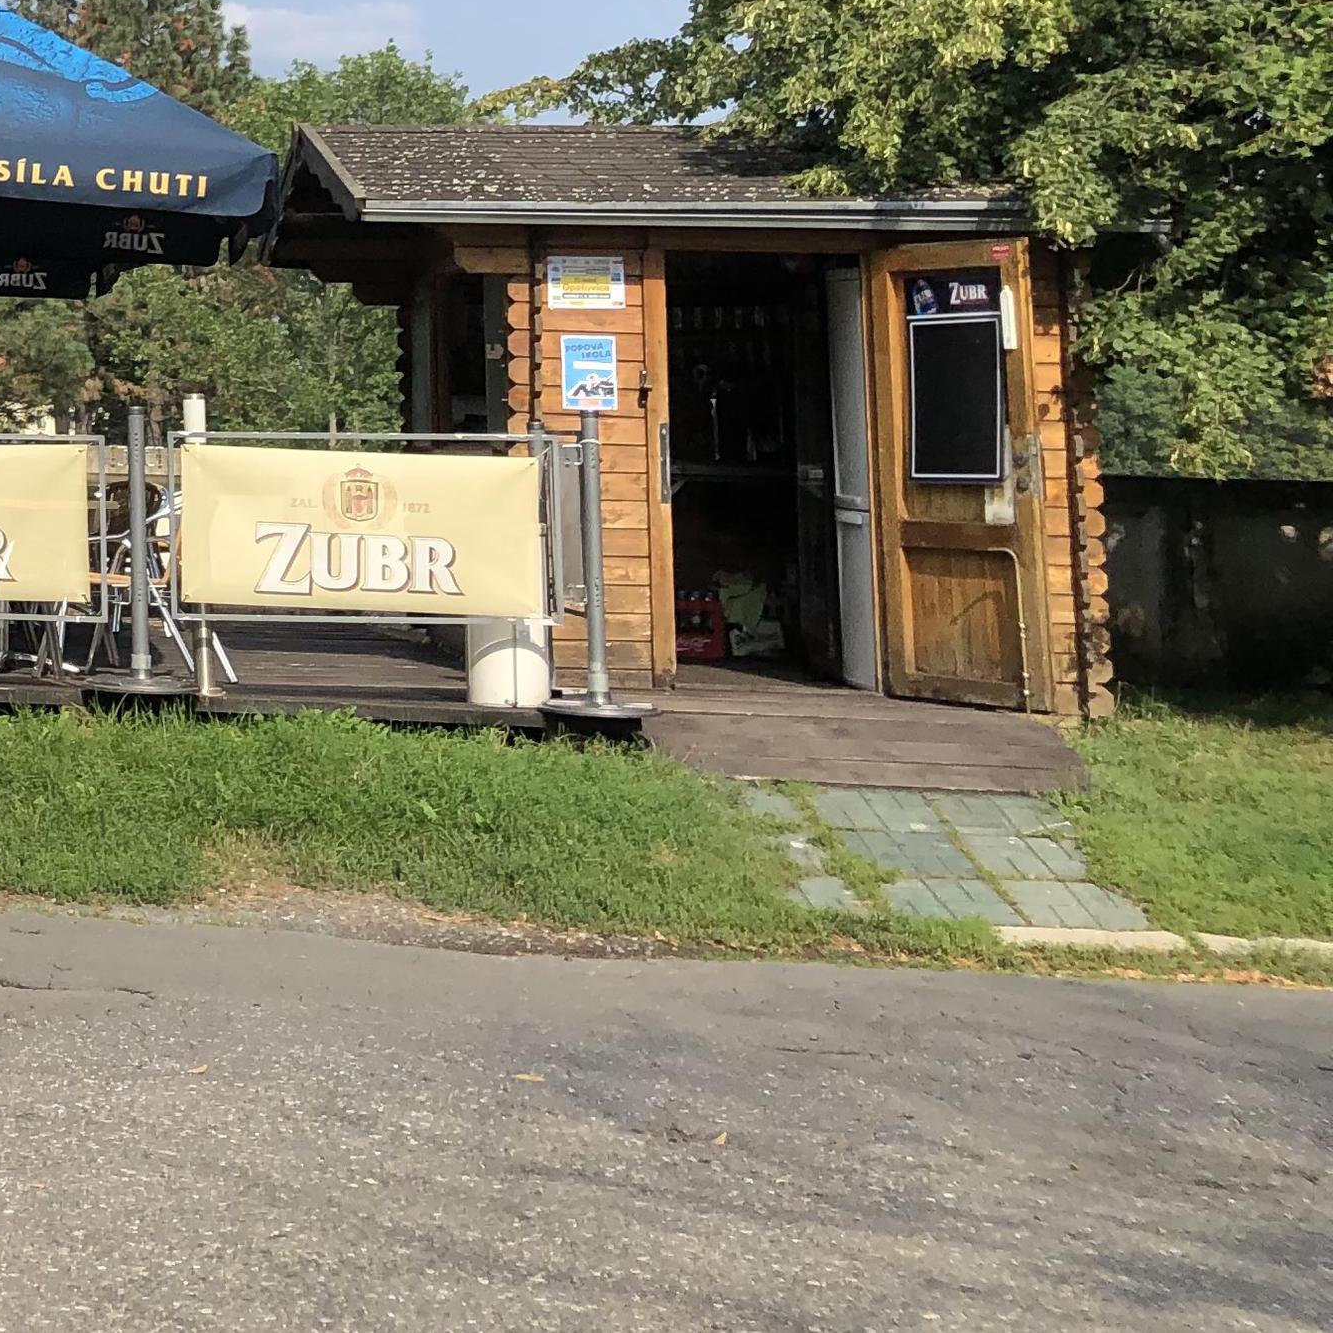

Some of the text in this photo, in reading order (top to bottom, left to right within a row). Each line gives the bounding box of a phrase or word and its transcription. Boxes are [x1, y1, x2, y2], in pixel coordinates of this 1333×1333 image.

[95, 167, 208, 198] CHUTI
[948, 281, 989, 305] ZUBR
[402, 503, 430, 513] 1872
[254, 521, 466, 596] ZUBR
